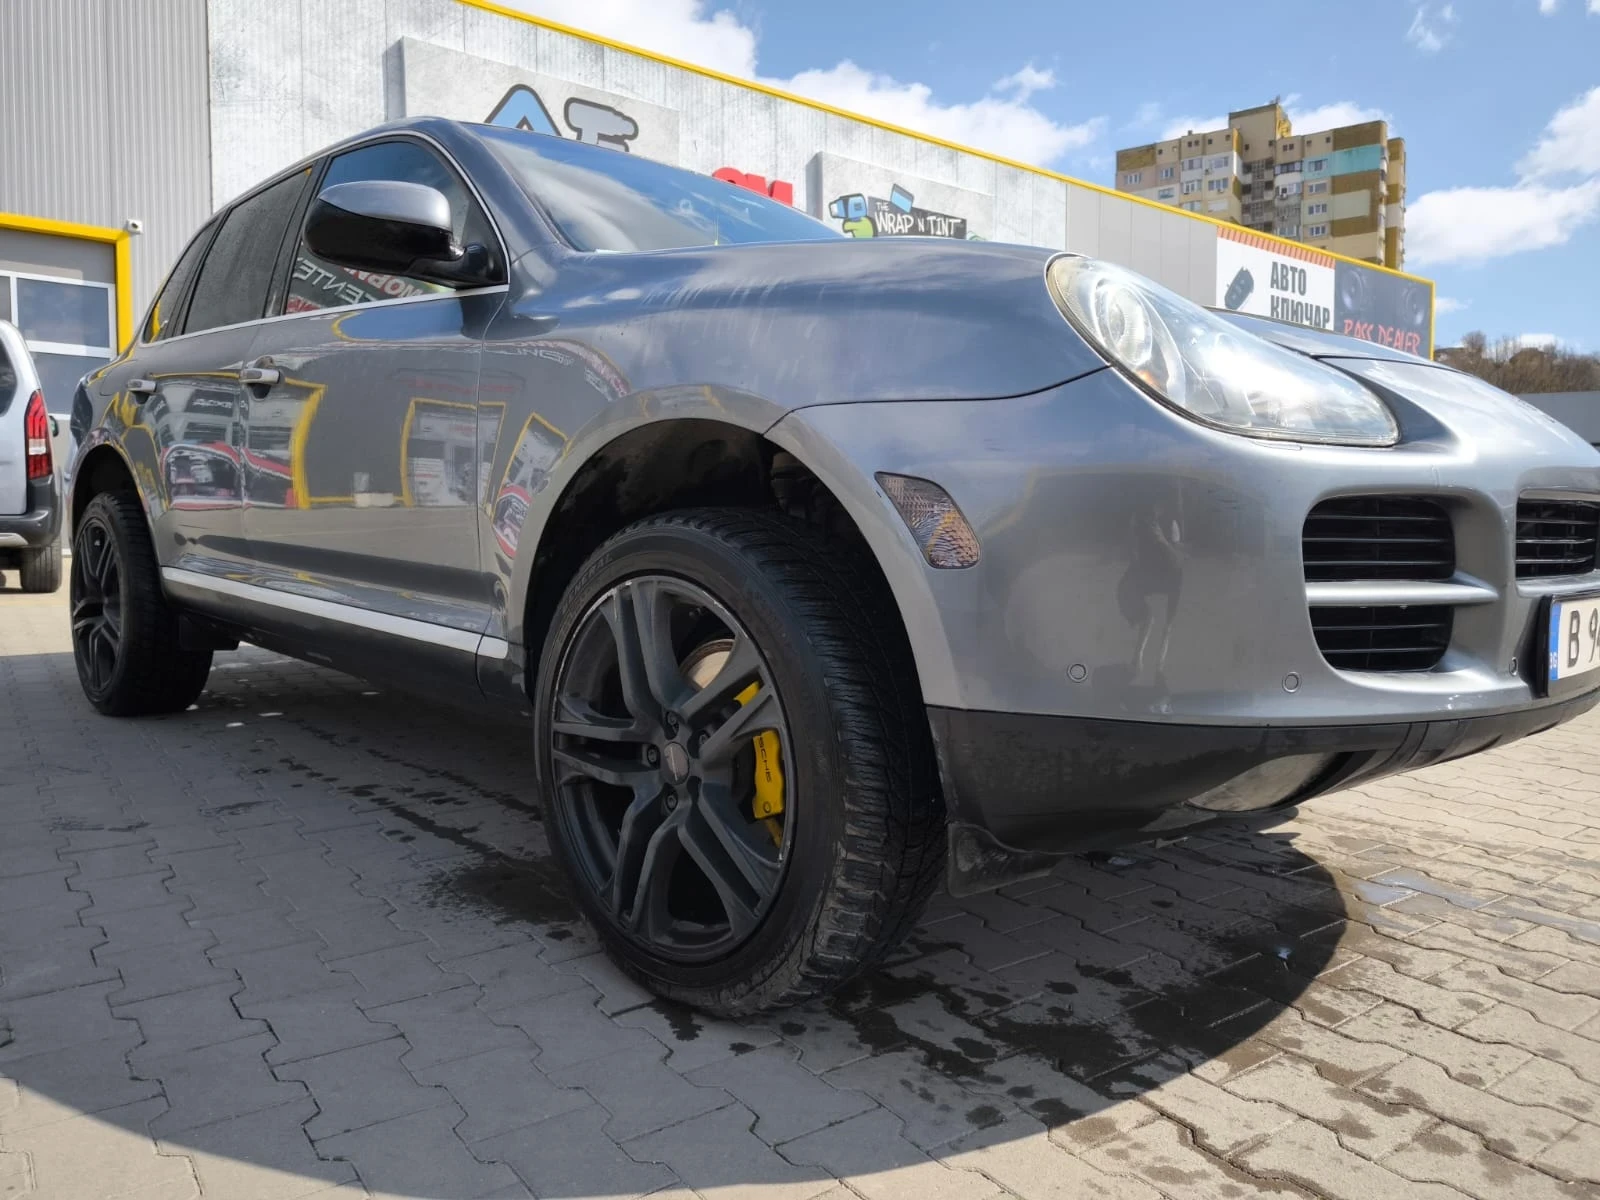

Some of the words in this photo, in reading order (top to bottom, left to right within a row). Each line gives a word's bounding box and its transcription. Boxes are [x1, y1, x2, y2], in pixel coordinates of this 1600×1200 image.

[876, 202, 889, 211] THE
[875, 212, 914, 234] WRAP
[918, 218, 925, 233] N
[927, 216, 962, 237] TINT
[1270, 261, 1307, 296] АВТО
[1567, 610, 1580, 669] B
[1588, 607, 1600, 663] 9
